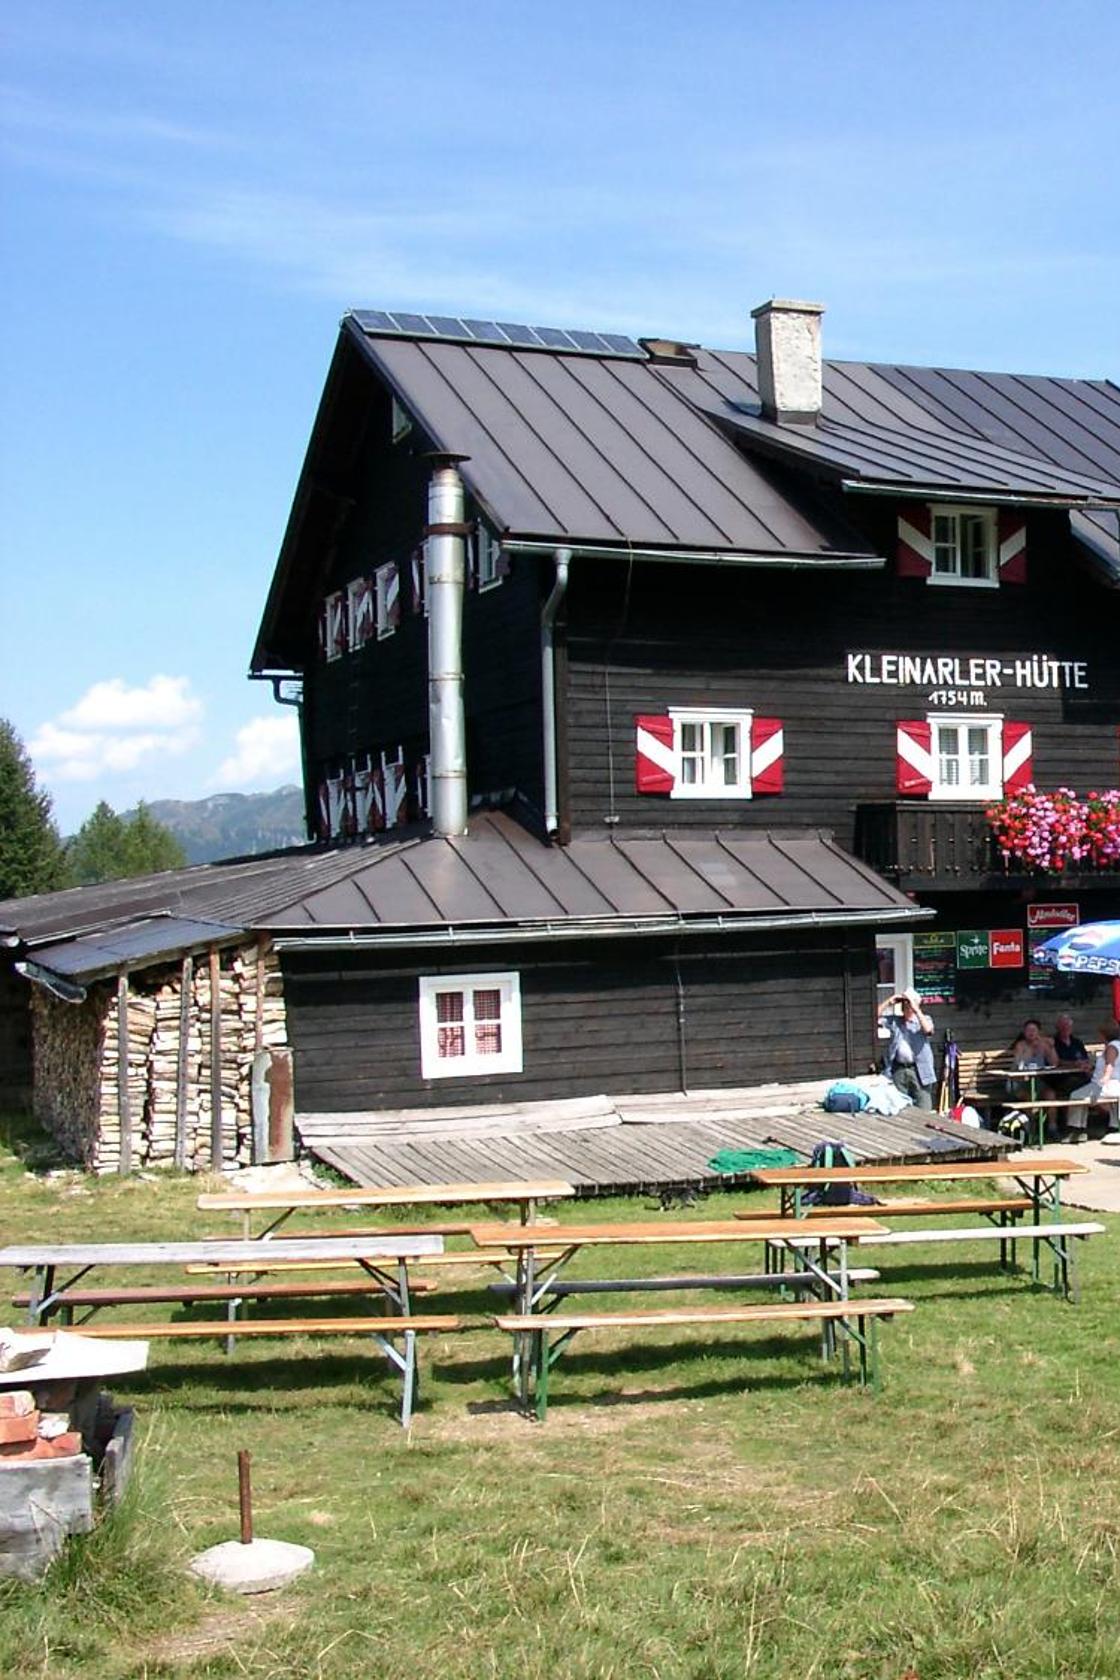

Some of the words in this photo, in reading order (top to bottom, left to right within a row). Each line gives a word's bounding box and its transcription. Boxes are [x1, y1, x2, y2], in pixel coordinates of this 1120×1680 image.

[847, 653, 1089, 689] KLEINARLER-HÜTTE
[959, 943, 988, 959] Sprite
[992, 941, 1021, 955] Fanta
